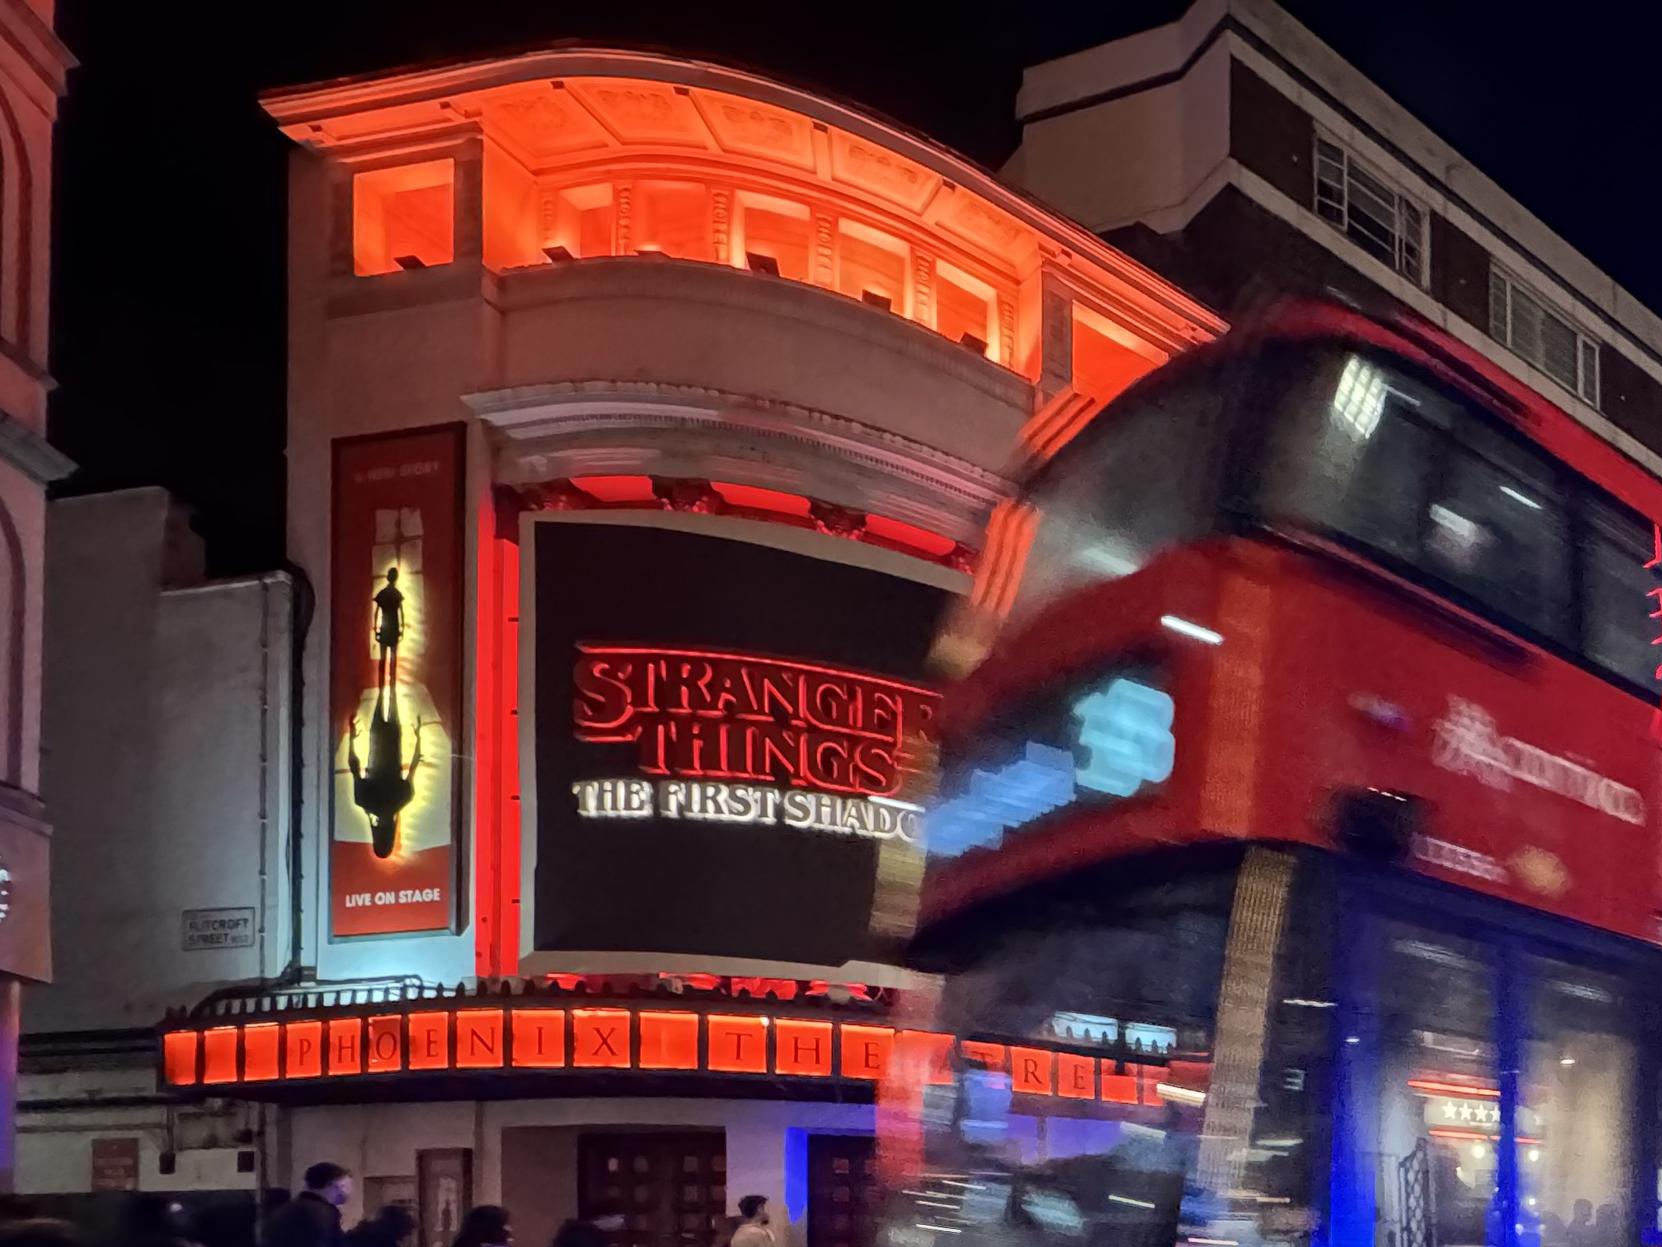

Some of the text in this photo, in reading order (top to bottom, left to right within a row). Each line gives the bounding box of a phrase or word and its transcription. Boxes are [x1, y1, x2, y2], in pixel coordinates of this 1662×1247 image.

[636, 718, 904, 798] THINGS
[572, 780, 932, 844] THE FIRST SHADO
[345, 888, 441, 908] LIVE ON STAGE
[299, 1027, 618, 1067] PHOENIX
